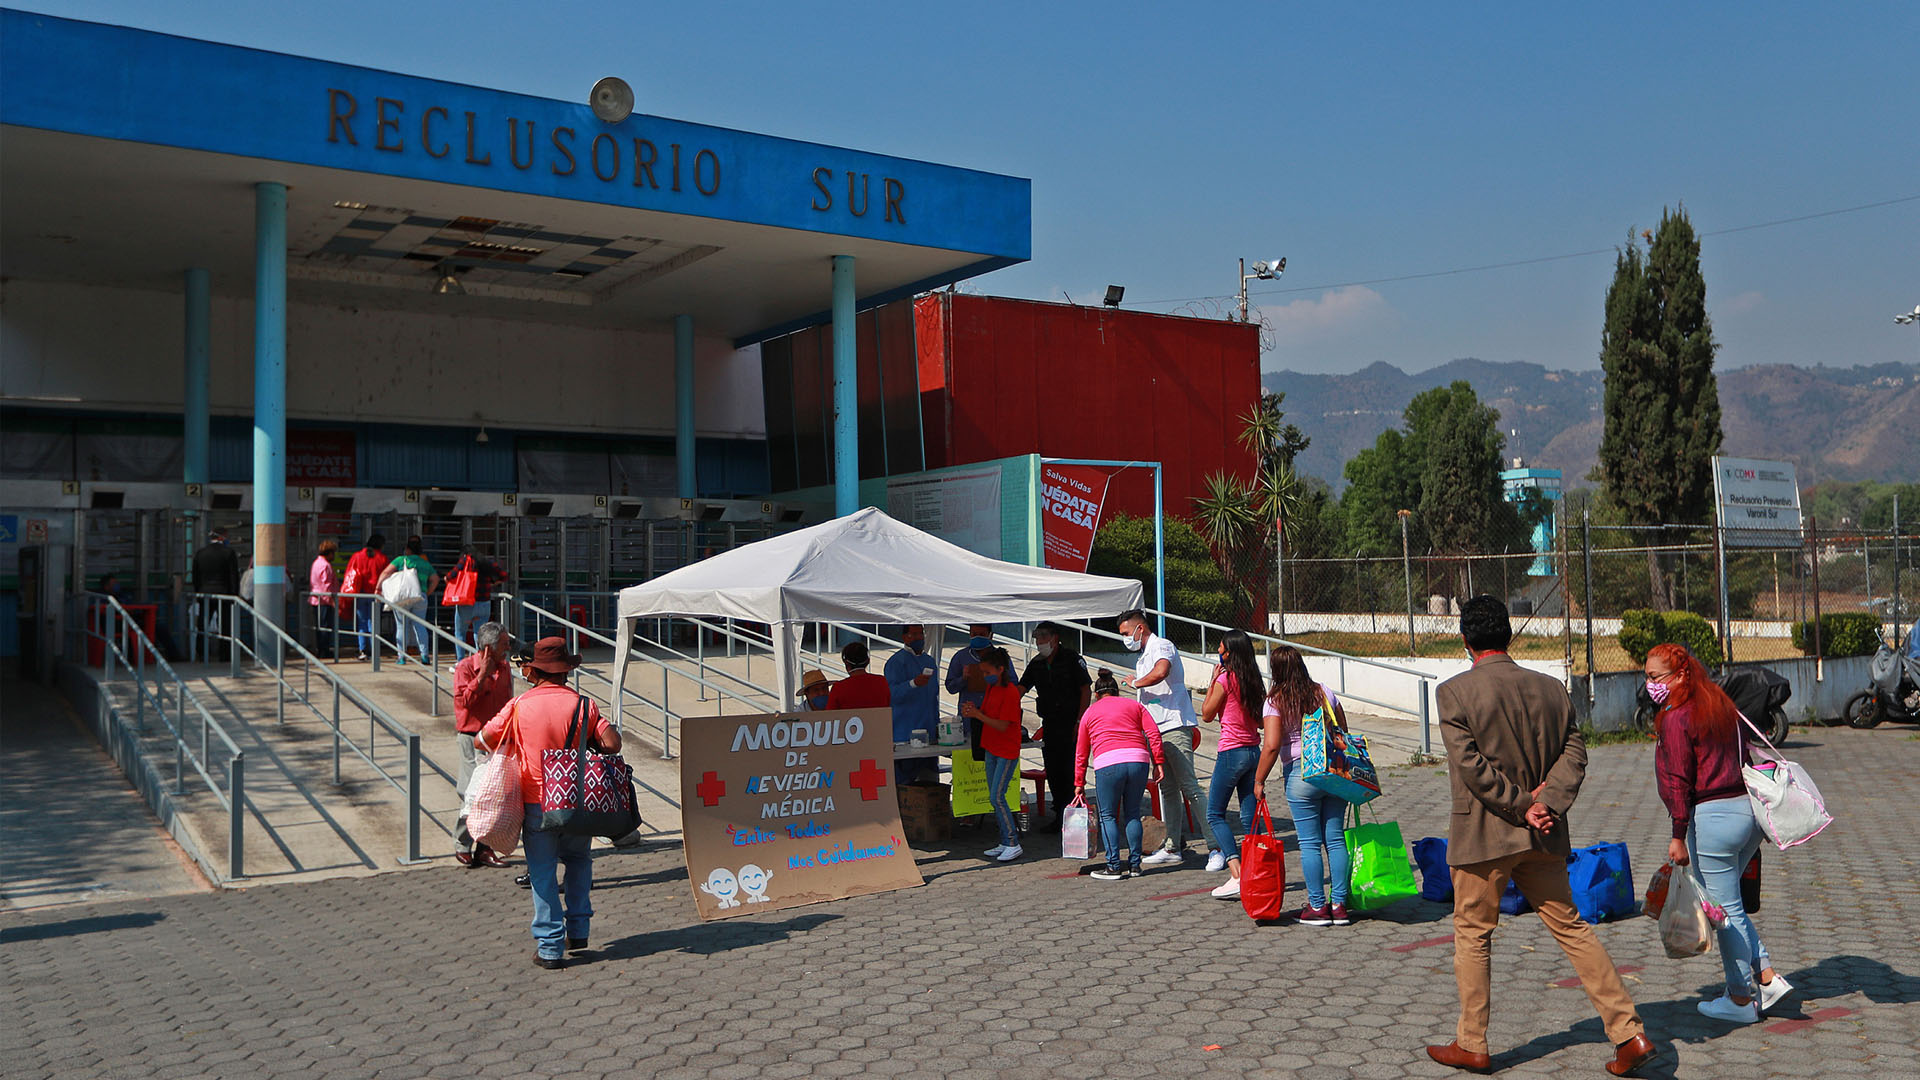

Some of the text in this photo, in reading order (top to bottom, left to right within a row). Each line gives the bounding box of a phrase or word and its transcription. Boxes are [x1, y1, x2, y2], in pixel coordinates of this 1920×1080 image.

[326, 87, 906, 225] RECLUSORIO SUR
[1046, 469, 1092, 493] Salva Vidas
[1730, 494, 1792, 506] Reclusorio Preventivo
[1052, 502, 1093, 530] CASA
[1747, 508, 1778, 518] Varonil Sur
[785, 751, 808, 767] DE
[745, 766, 835, 795] REVISIÓN
[761, 793, 836, 819] MÉDICA
[785, 819, 832, 839] Todos
[788, 853, 814, 870] Nos
